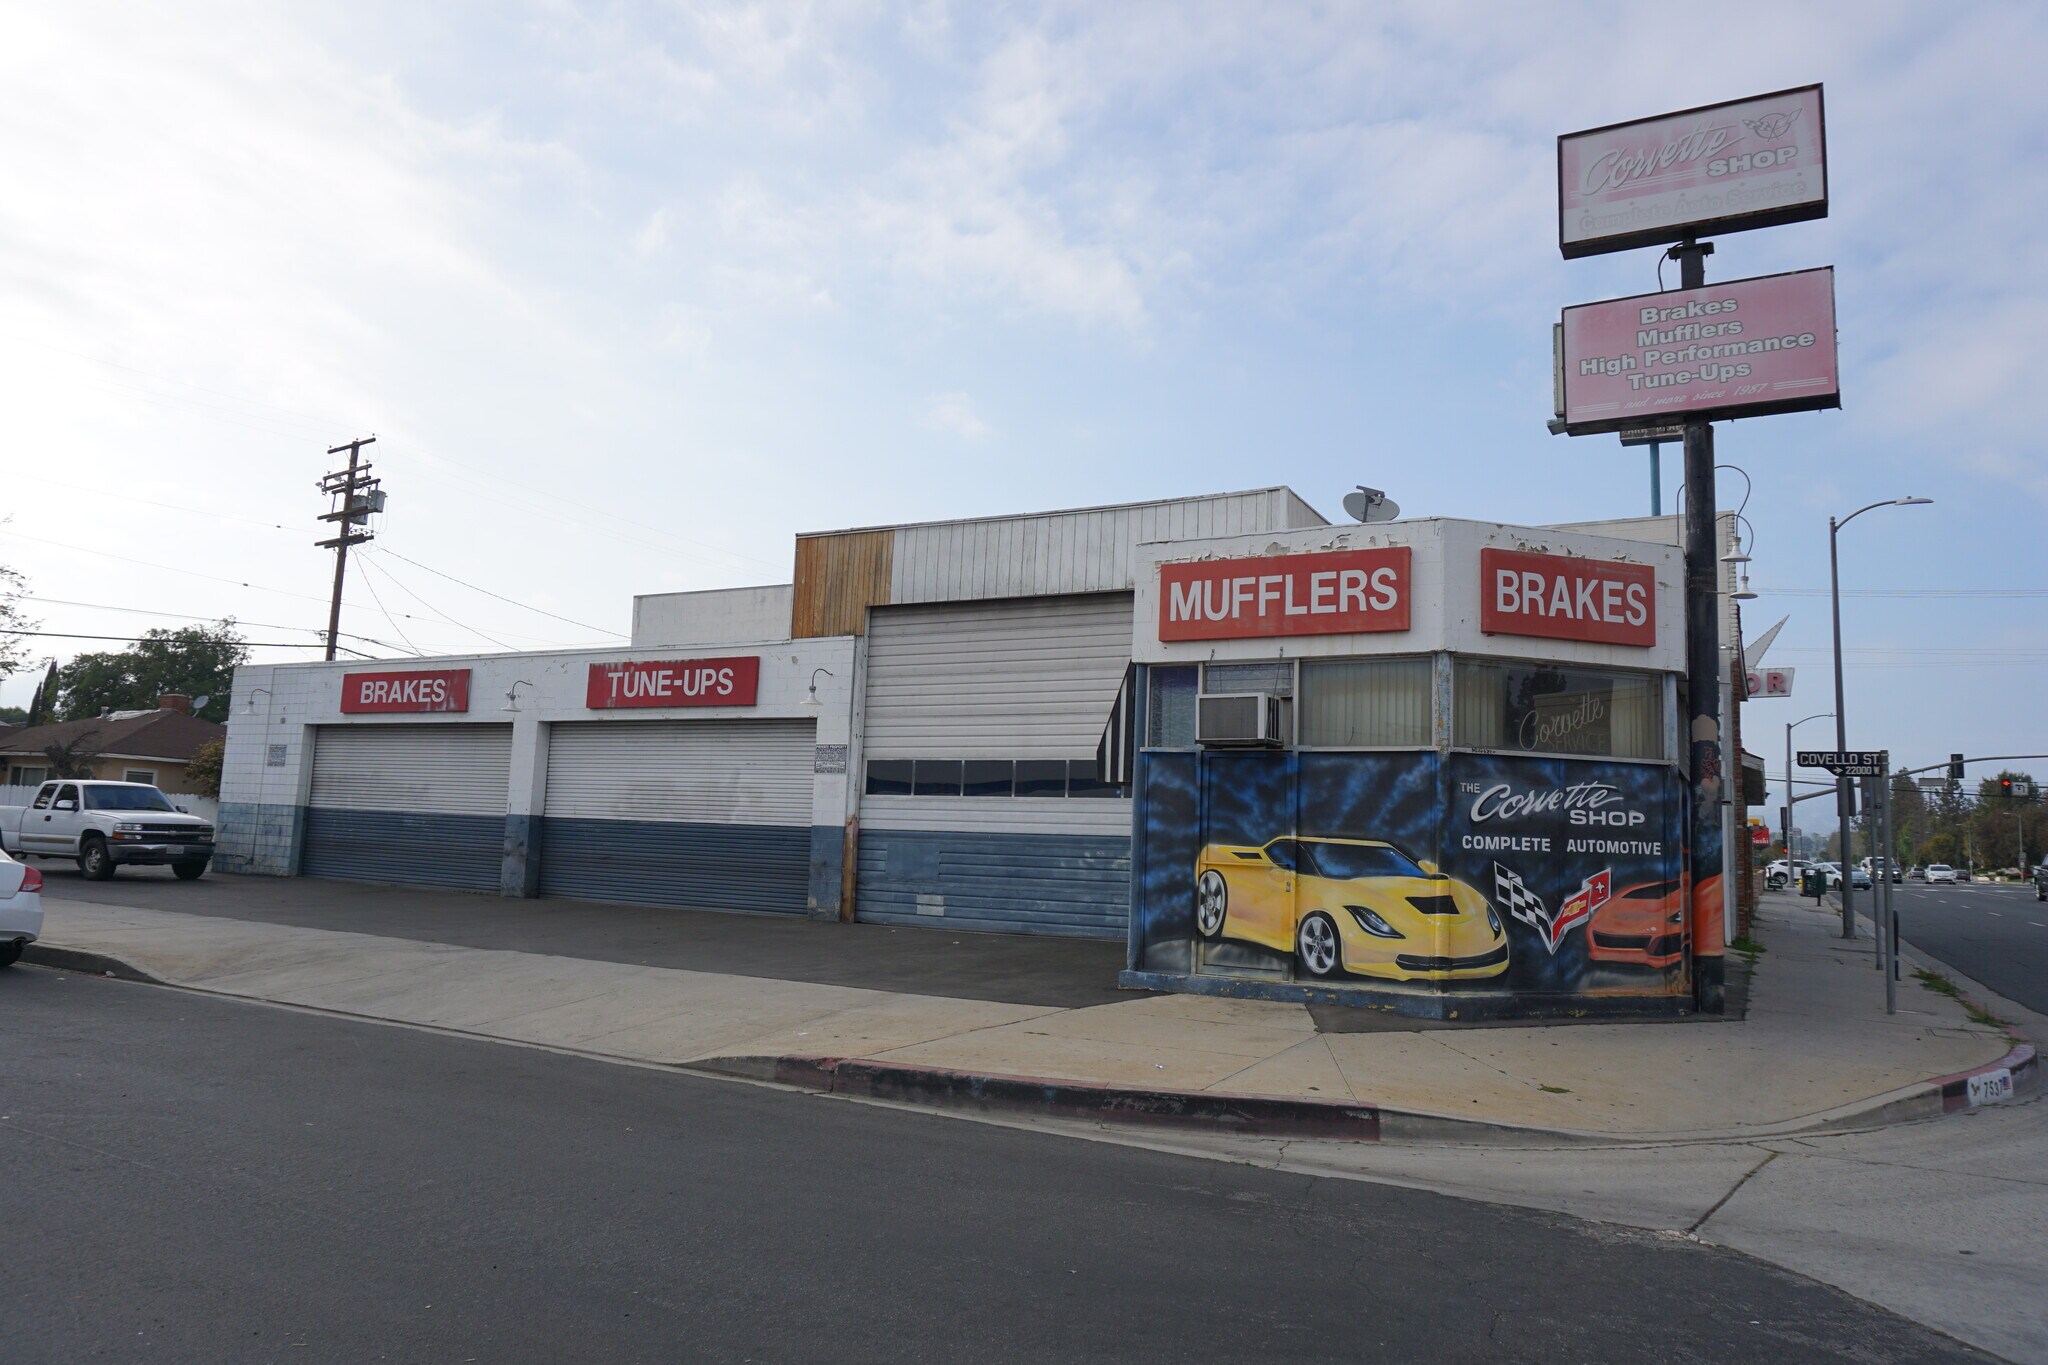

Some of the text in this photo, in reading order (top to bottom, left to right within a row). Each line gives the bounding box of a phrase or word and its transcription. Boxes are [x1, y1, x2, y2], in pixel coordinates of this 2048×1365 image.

[1583, 122, 1746, 195] Corvette
[1707, 146, 1798, 177] SHOP
[1580, 180, 1808, 232] Complete Auto Service
[1640, 299, 1738, 325] Brakes
[1636, 321, 1743, 347] Mufflers
[1580, 333, 1815, 376] High Performance
[1627, 363, 1751, 391] Tune-Ups
[1624, 383, 1768, 409] and more since 1987
[1169, 567, 1398, 622] MUFFLERS
[1497, 569, 1647, 626] BRAKES
[360, 679, 446, 704] BRAKES
[608, 668, 734, 697] TUNE-UPS
[1519, 691, 1604, 750] Corvette
[1800, 753, 1858, 765] COVELLO
[1846, 766, 1872, 775] 22000
[1460, 782, 1480, 794] THE
[1470, 781, 1624, 823] Corvette
[1569, 810, 1645, 826] SHOP
[1462, 835, 1662, 855] COMPLETE AUTOMOTIVE
